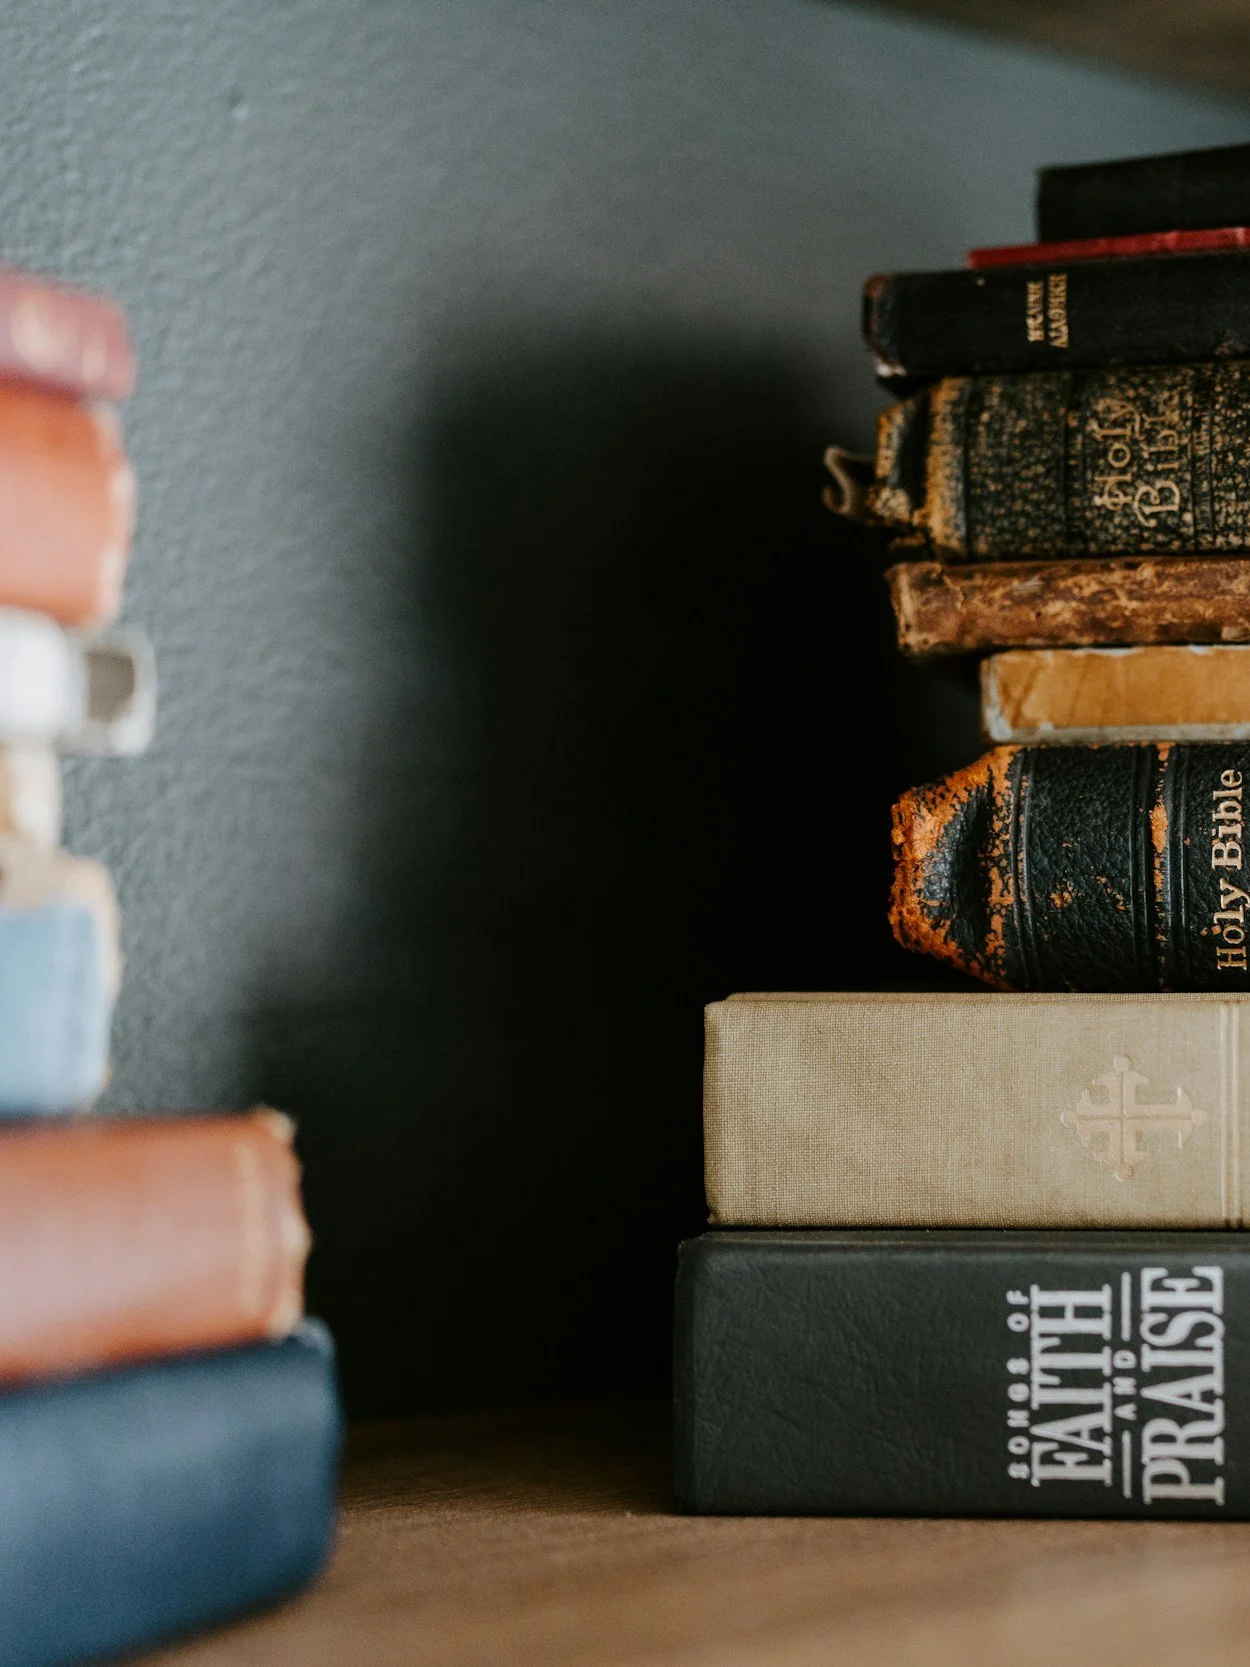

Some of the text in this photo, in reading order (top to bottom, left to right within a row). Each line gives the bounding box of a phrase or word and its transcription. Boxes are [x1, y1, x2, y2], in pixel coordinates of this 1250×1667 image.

[1091, 399, 1141, 510] Holy
[1134, 398, 1181, 527] Bibl
[1212, 769, 1250, 970] Holy Bible
[1006, 1289, 1030, 1479] SONGS OF
[1029, 1284, 1113, 1488] FAITH
[1113, 1350, 1137, 1421] AND
[1140, 1266, 1225, 1506] PRAISE
